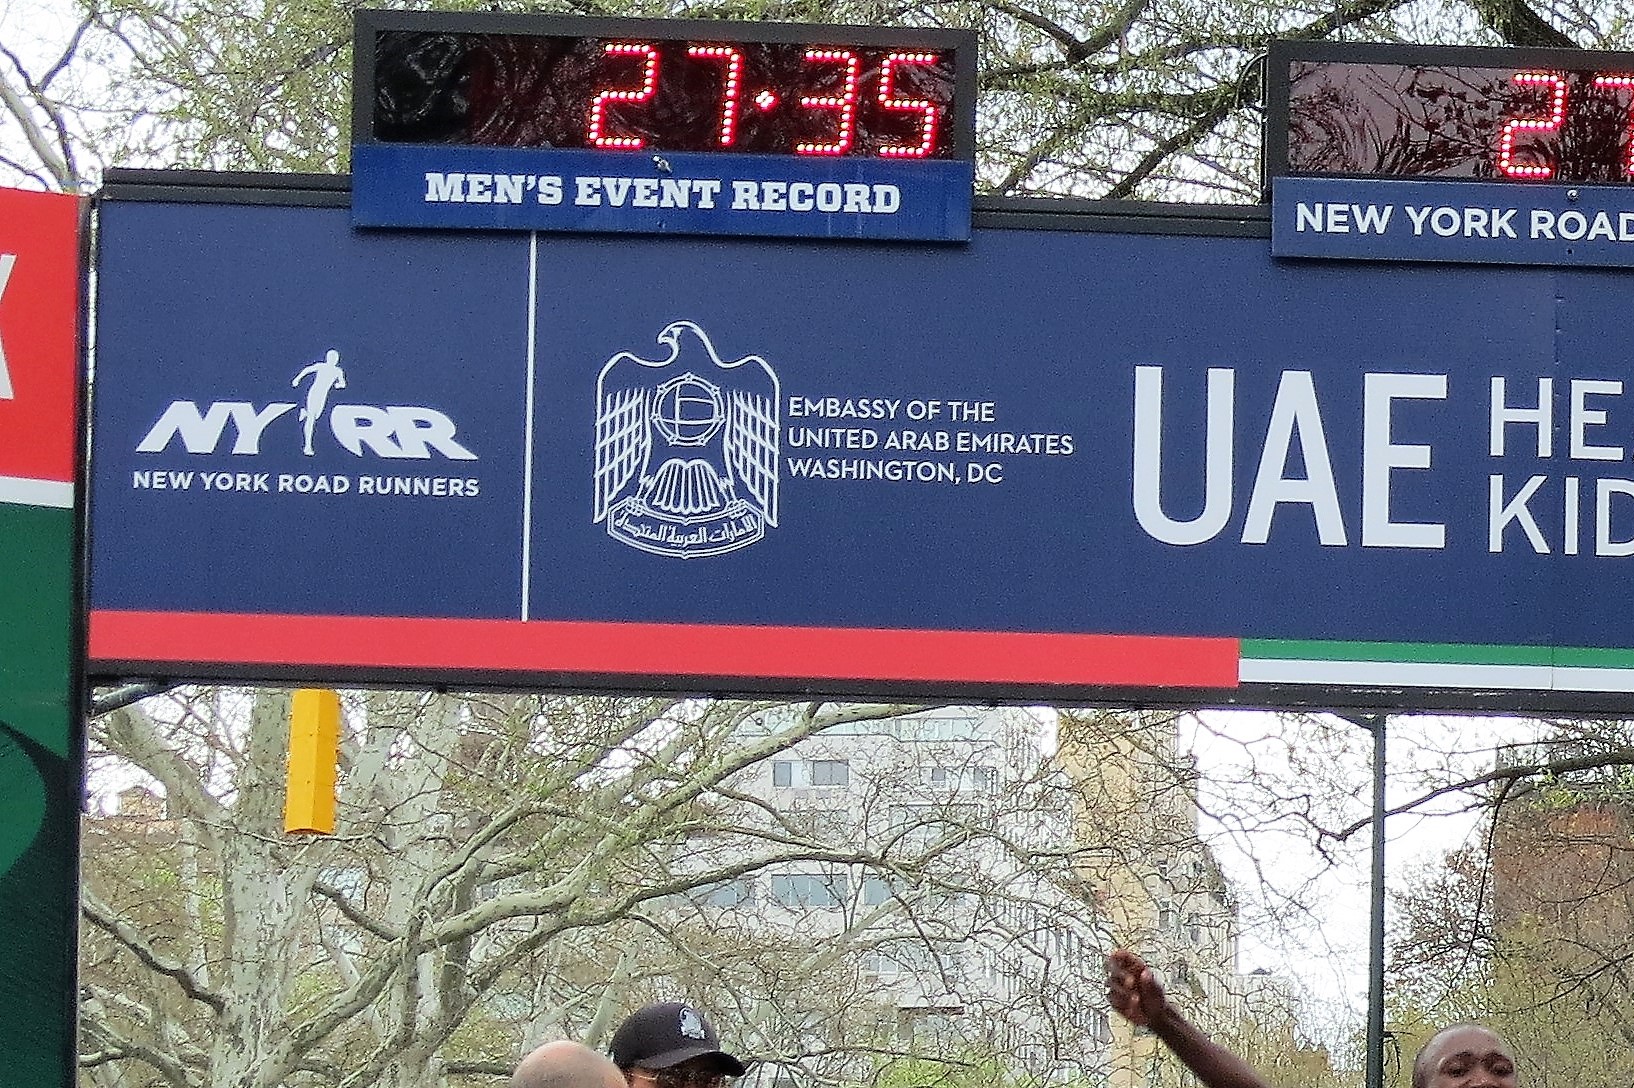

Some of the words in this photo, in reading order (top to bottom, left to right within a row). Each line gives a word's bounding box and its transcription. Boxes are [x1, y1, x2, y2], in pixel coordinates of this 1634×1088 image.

[424, 172, 563, 205] MEN'S
[574, 176, 723, 209] EVENT
[731, 180, 900, 214] RECORD
[1296, 202, 1392, 234] NEW
[1404, 206, 1518, 239] YORK
[787, 395, 899, 420] EMBASSY
[906, 399, 941, 420] OF
[947, 401, 996, 422] THE
[788, 426, 878, 449] UNITED
[883, 430, 950, 451] ARAB
[956, 432, 1074, 455] EMIRATES
[787, 457, 961, 485] WASHINGTON,
[967, 462, 1004, 484] DC
[1133, 365, 1448, 549] UAE
[133, 470, 195, 490] NEW
[199, 471, 270, 492] YORK
[278, 474, 350, 494] ROAD
[358, 475, 479, 497] RUNNERS
